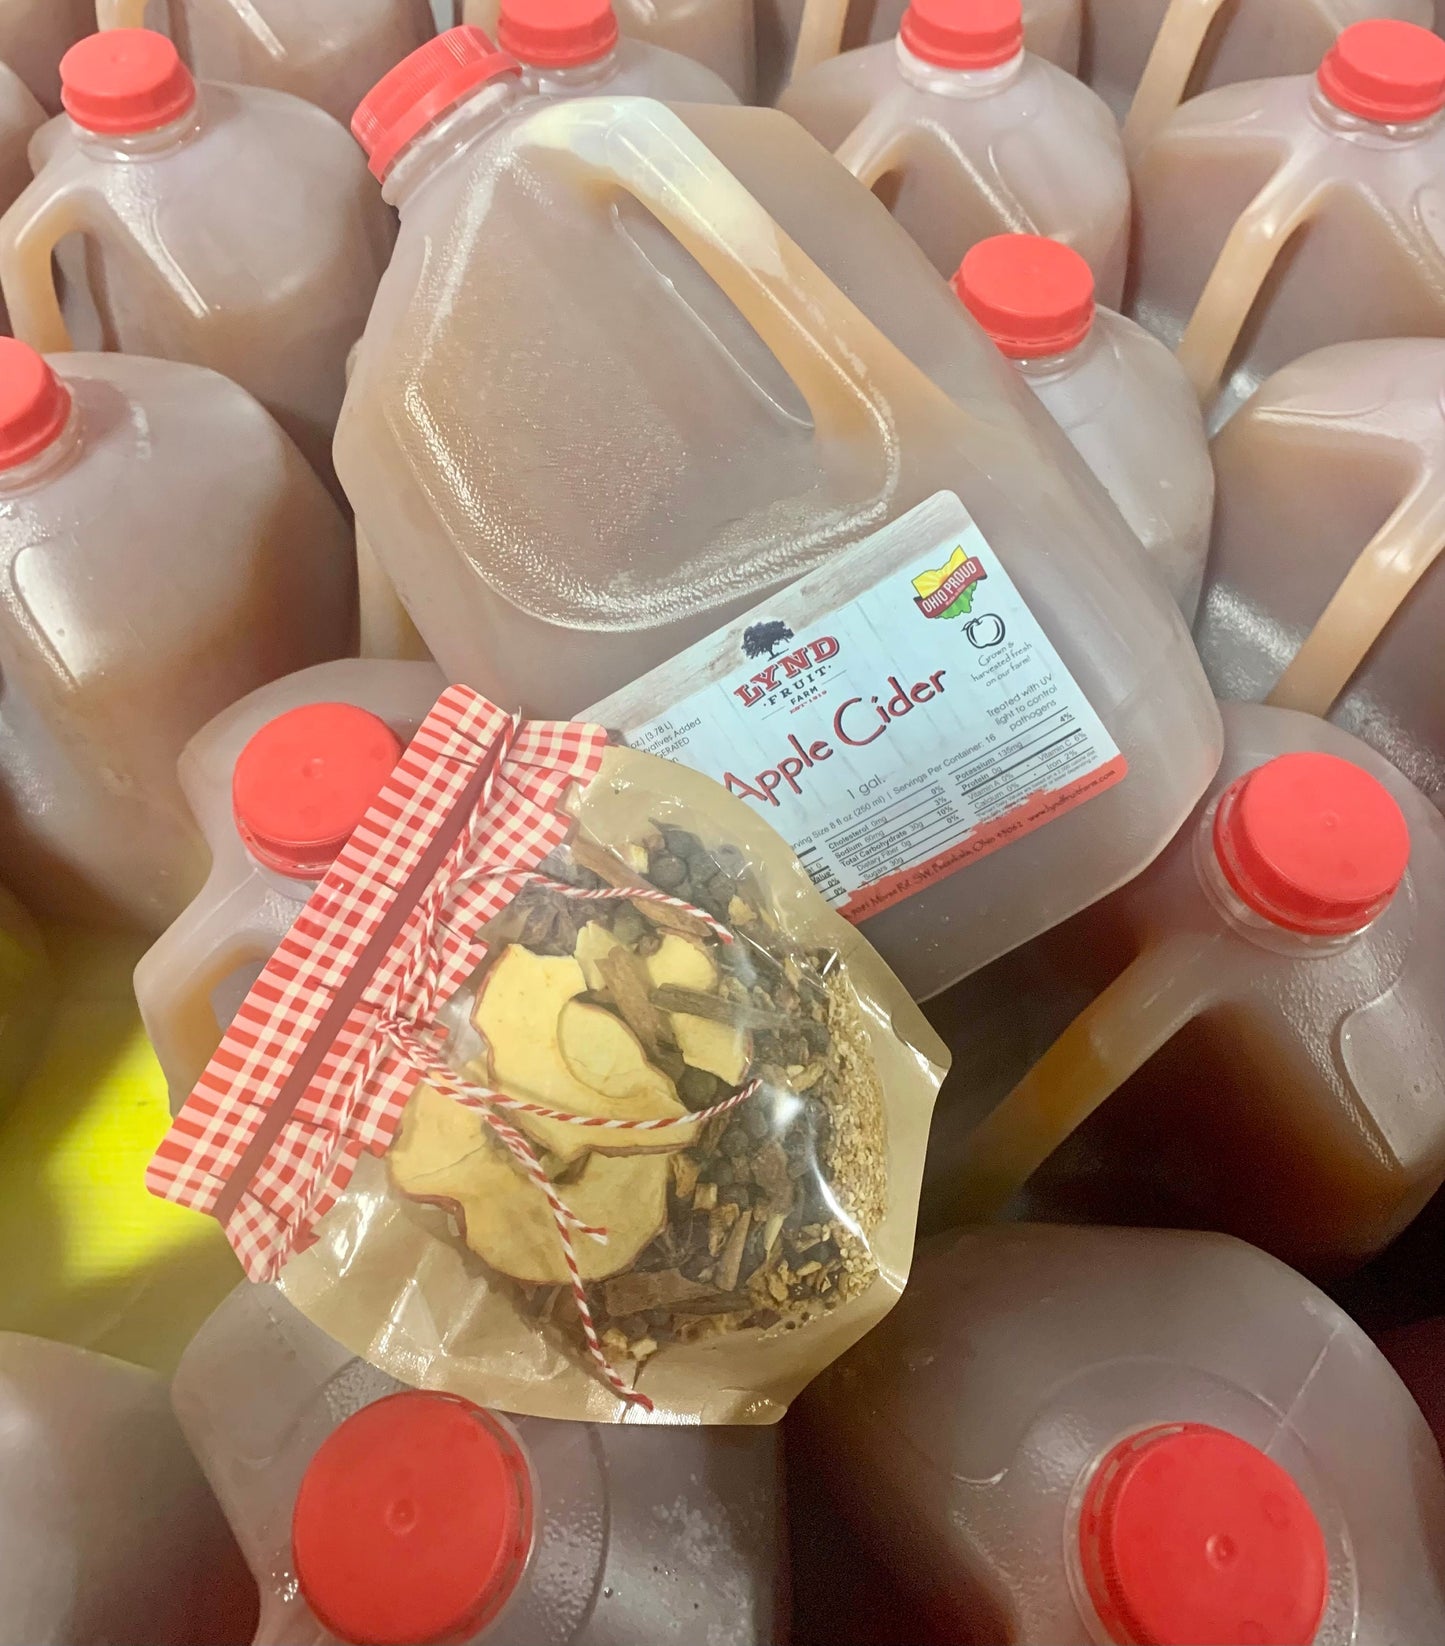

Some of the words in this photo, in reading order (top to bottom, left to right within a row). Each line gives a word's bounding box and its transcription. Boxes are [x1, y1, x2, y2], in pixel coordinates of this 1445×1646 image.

[922, 589, 948, 611] OHIO
[943, 560, 977, 593] PROUD
[733, 637, 840, 708] LYND
[970, 653, 1011, 682] harvested
[1010, 642, 1032, 657] fresh
[978, 647, 1007, 667] Grown
[986, 678, 996, 687] on
[997, 669, 1010, 679] our
[1010, 655, 1030, 671] farm!
[768, 665, 826, 705] FRUIT
[790, 686, 818, 705] FARM
[986, 693, 1021, 717] Treated
[1021, 683, 1040, 696] with
[1039, 673, 1052, 685] UV
[994, 710, 1015, 726] light
[1015, 705, 1026, 713] to
[1026, 684, 1057, 707] control
[1009, 700, 1056, 731] pathogens
[643, 734, 673, 754] rvatives
[674, 717, 701, 737] Added
[645, 725, 665, 741] (3.78
[654, 737, 690, 759] GERATED
[723, 733, 833, 807] Apple
[834, 670, 945, 746] Cider
[955, 757, 995, 781] Potassium
[998, 741, 1023, 757] 135mg
[1060, 712, 1072, 722] 4%
[1037, 745, 1064, 761] Vitamin
[1064, 738, 1072, 747] C
[1073, 732, 1087, 741] 6%
[1046, 759, 1062, 770] Iron
[1064, 749, 1078, 759] 2%
[812, 827, 830, 838] Size
[843, 814, 853, 822] oz
[853, 802, 871, 817] (250
[872, 795, 886, 807] ml)
[893, 773, 928, 795] Servings
[927, 764, 942, 775] Per
[943, 742, 984, 767] Container:
[985, 733, 996, 743] 16
[847, 789, 855, 799] 1
[859, 774, 886, 796] gal.
[961, 773, 989, 790] Protein
[991, 766, 1002, 775] 0g
[967, 784, 993, 800] Vitamin
[1001, 772, 1013, 782] 0%
[974, 791, 1004, 809] Calcium
[1006, 782, 1020, 792] 0%
[828, 824, 869, 849] Cholesterol
[870, 816, 888, 827] 0mg
[931, 785, 943, 795] 0%
[834, 842, 862, 859] Sodium
[864, 830, 885, 843] 60mg
[934, 796, 946, 806] 3%
[841, 854, 859, 867] Total
[859, 830, 907, 858] Carbohydrate
[909, 821, 924, 831] 30g
[936, 805, 953, 816] 10%
[856, 856, 881, 872] Dietary
[880, 844, 899, 858] Fiber
[946, 814, 959, 824] 0%
[828, 878, 839, 887] 0%
[863, 863, 888, 880] Sugars
[889, 857, 904, 866] 30g
[833, 886, 846, 895] 0%
